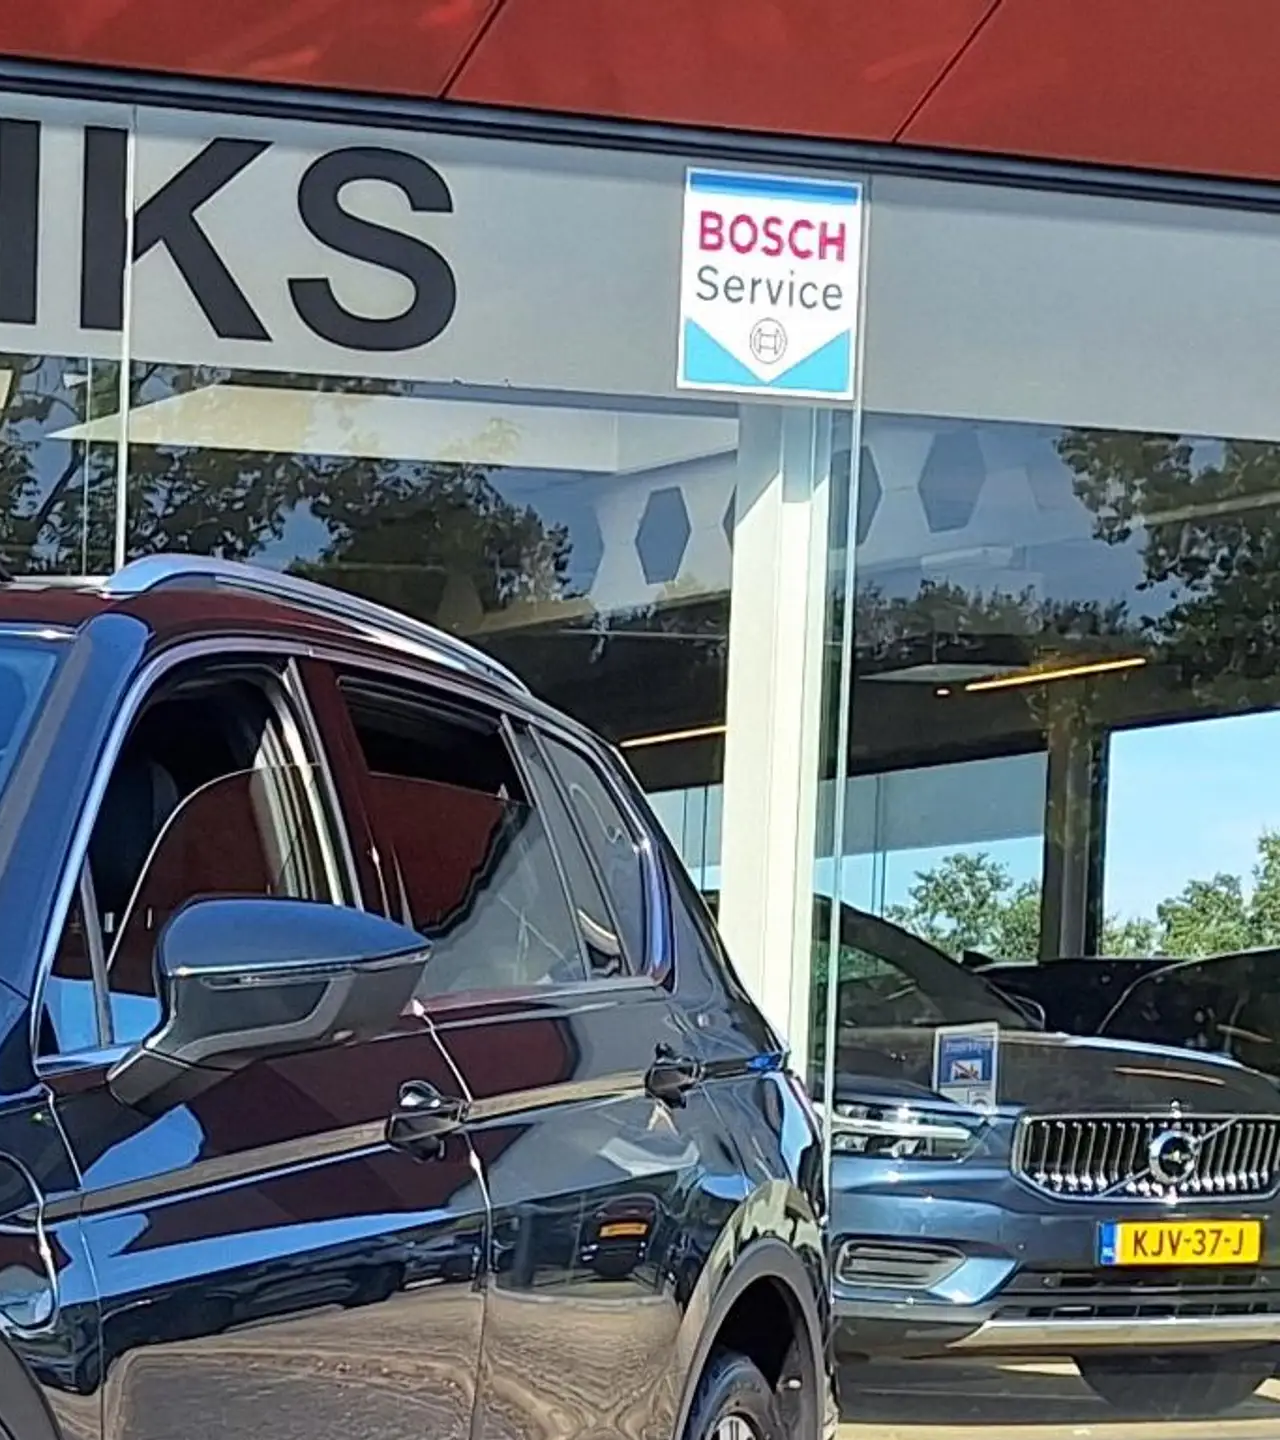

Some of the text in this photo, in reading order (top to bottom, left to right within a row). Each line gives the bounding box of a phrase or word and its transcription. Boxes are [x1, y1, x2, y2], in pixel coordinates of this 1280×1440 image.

[698, 210, 846, 261] BOSCH
[696, 265, 843, 311] Service
[1133, 1228, 1244, 1257] KJV-37-J
